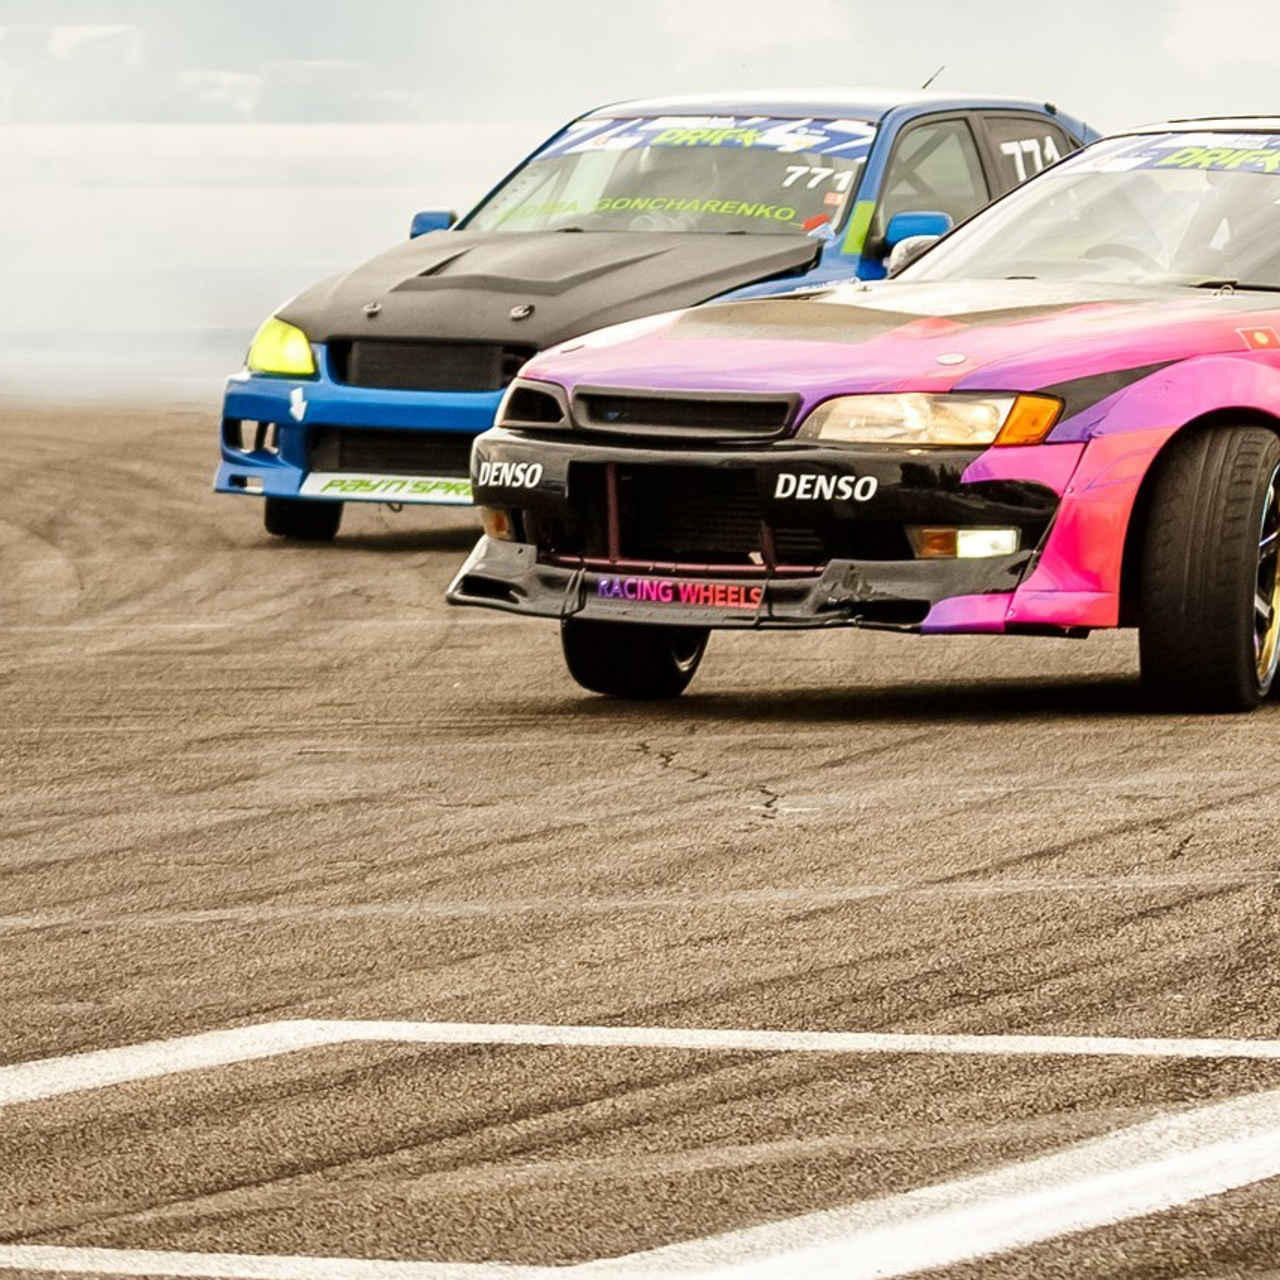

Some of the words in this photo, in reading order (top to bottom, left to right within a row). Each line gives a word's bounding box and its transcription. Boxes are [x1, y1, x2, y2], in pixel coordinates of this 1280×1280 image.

[782, 166, 853, 191] 771
[597, 197, 796, 221] GONCHARENKO
[478, 462, 543, 488] DENSO
[774, 473, 878, 501] DENSO
[597, 575, 673, 602] RACING
[677, 582, 763, 610] WHEELS
